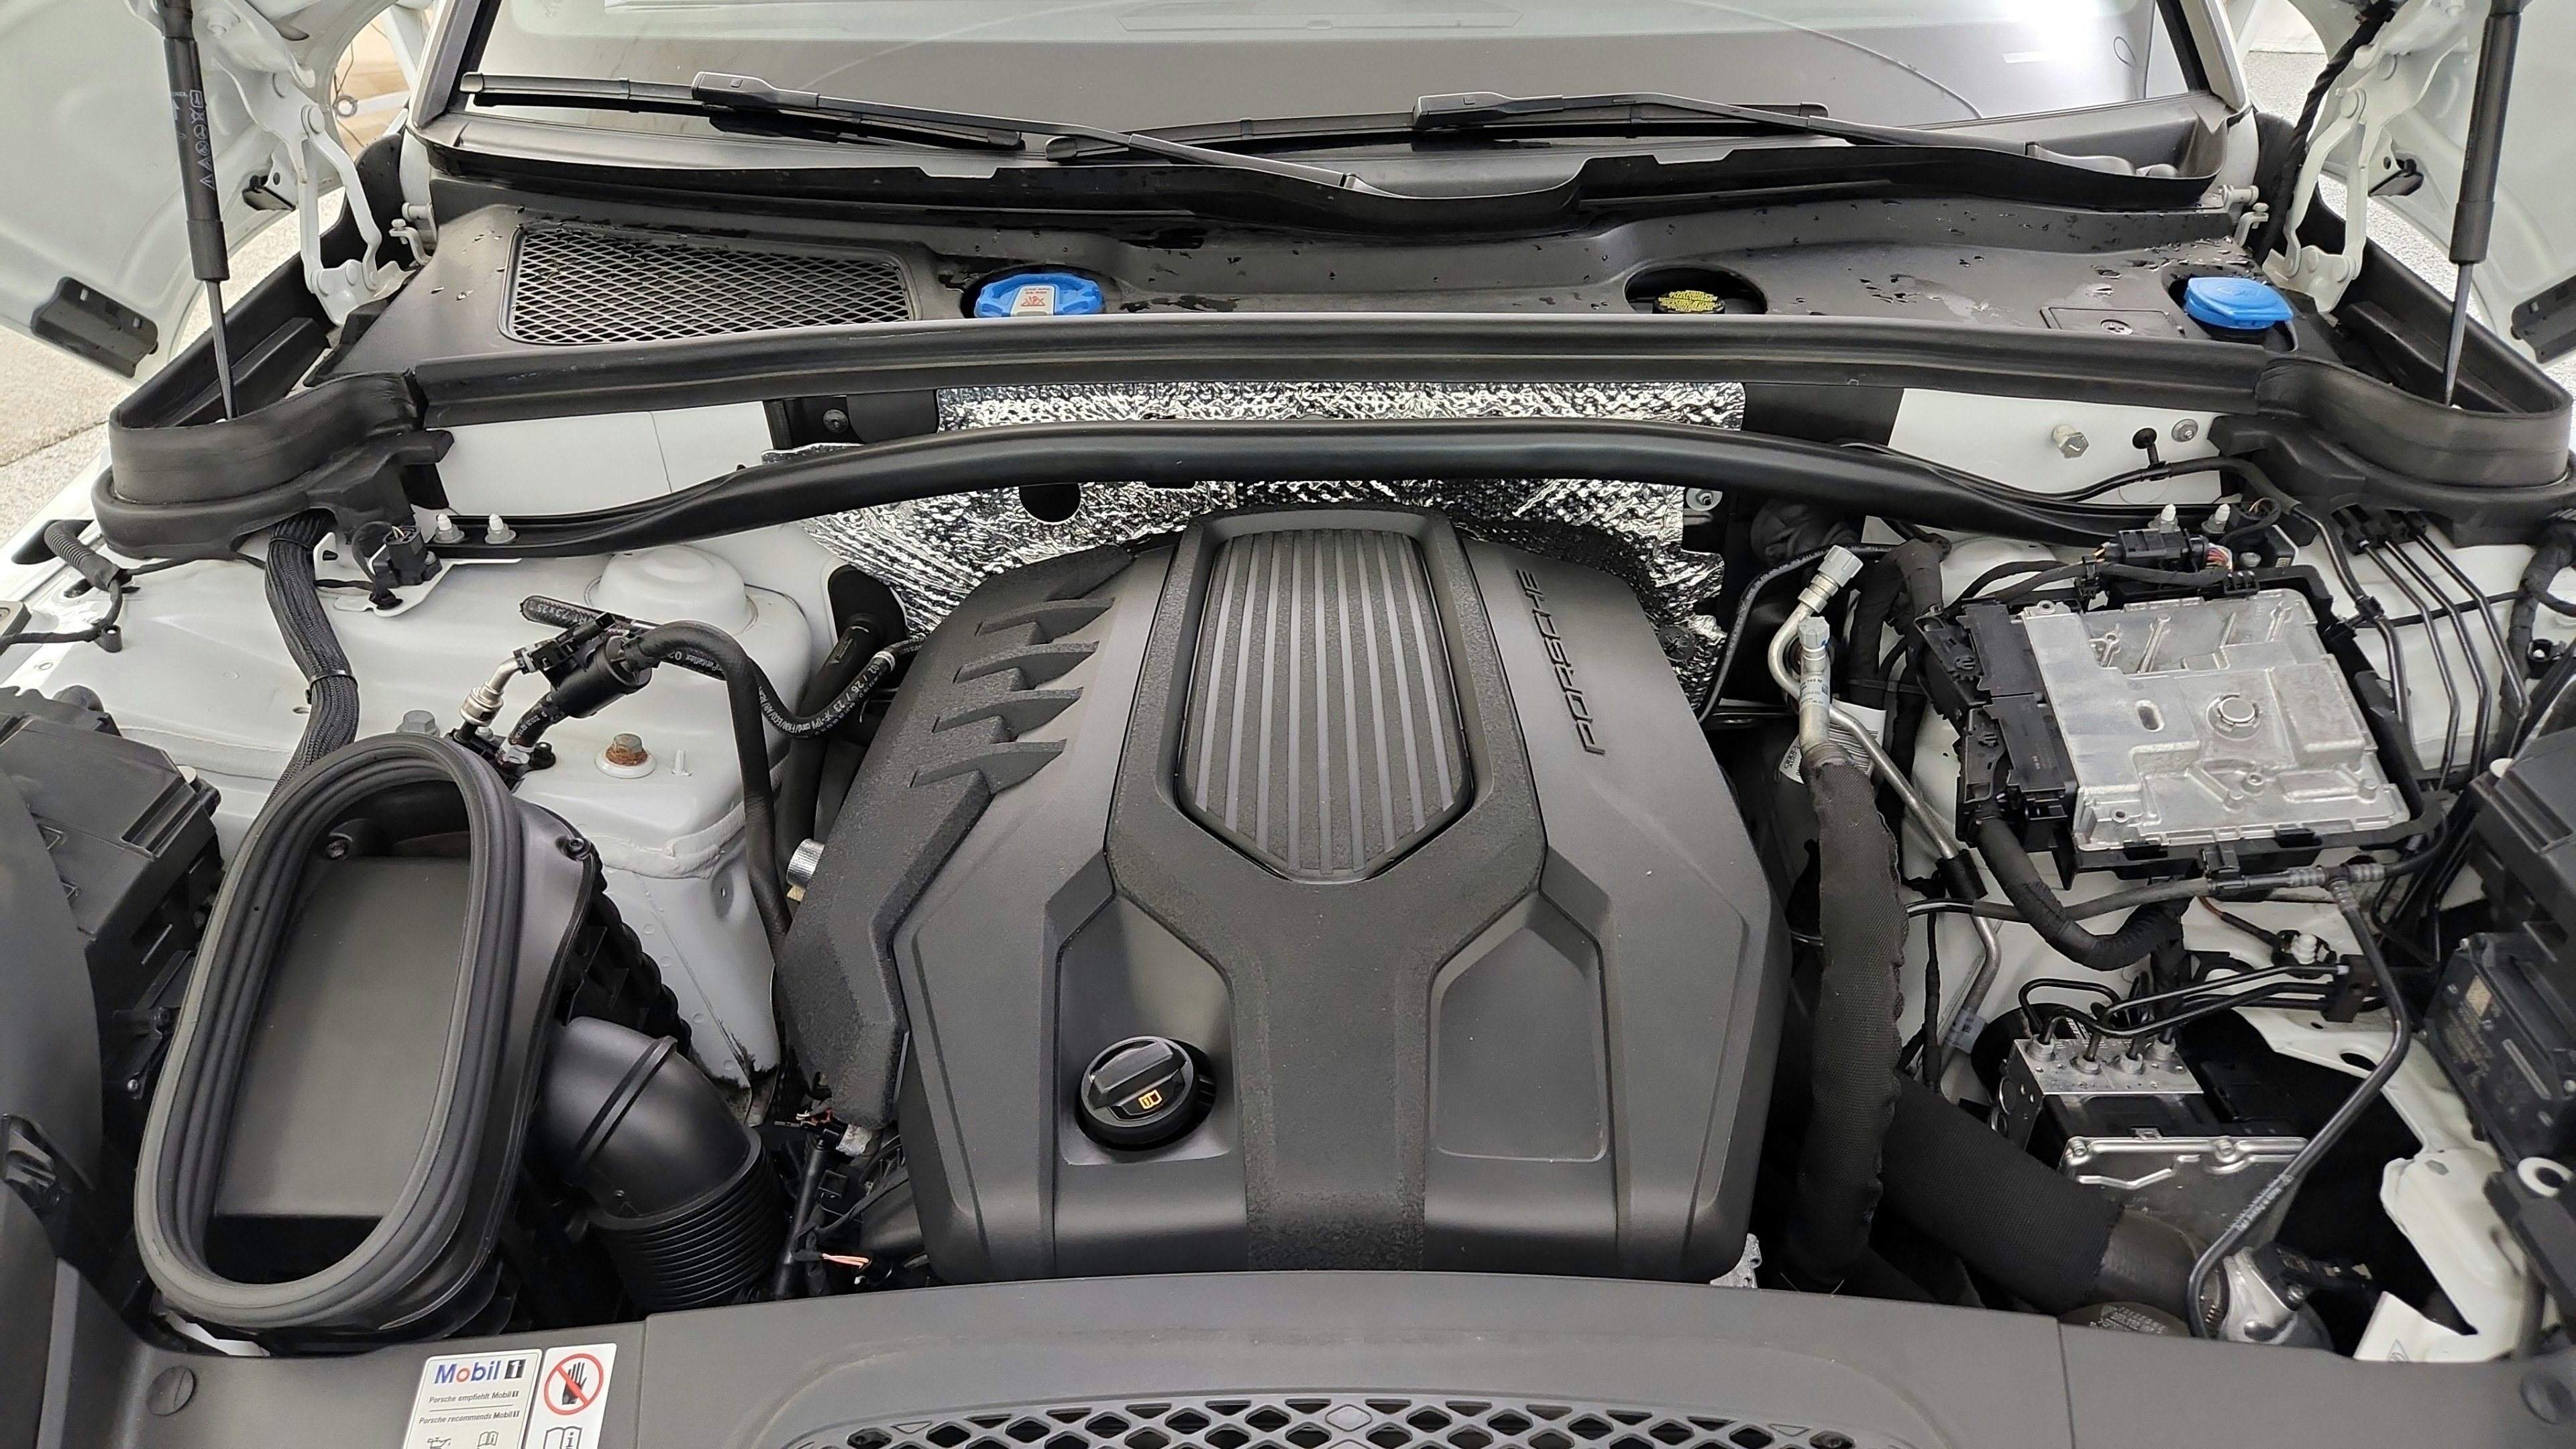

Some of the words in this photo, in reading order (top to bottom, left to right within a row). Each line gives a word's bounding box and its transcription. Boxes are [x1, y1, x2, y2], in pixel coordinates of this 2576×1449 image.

[1516, 569, 1605, 755] PORSCHE
[851, 680, 865, 694] 26
[833, 699, 845, 712] 23
[434, 1360, 501, 1384] Mobil
[429, 1393, 456, 1403] Porsche
[458, 1392, 490, 1402] empfiehlt
[419, 1415, 446, 1424] Porsche
[447, 1413, 492, 1422] recommends
